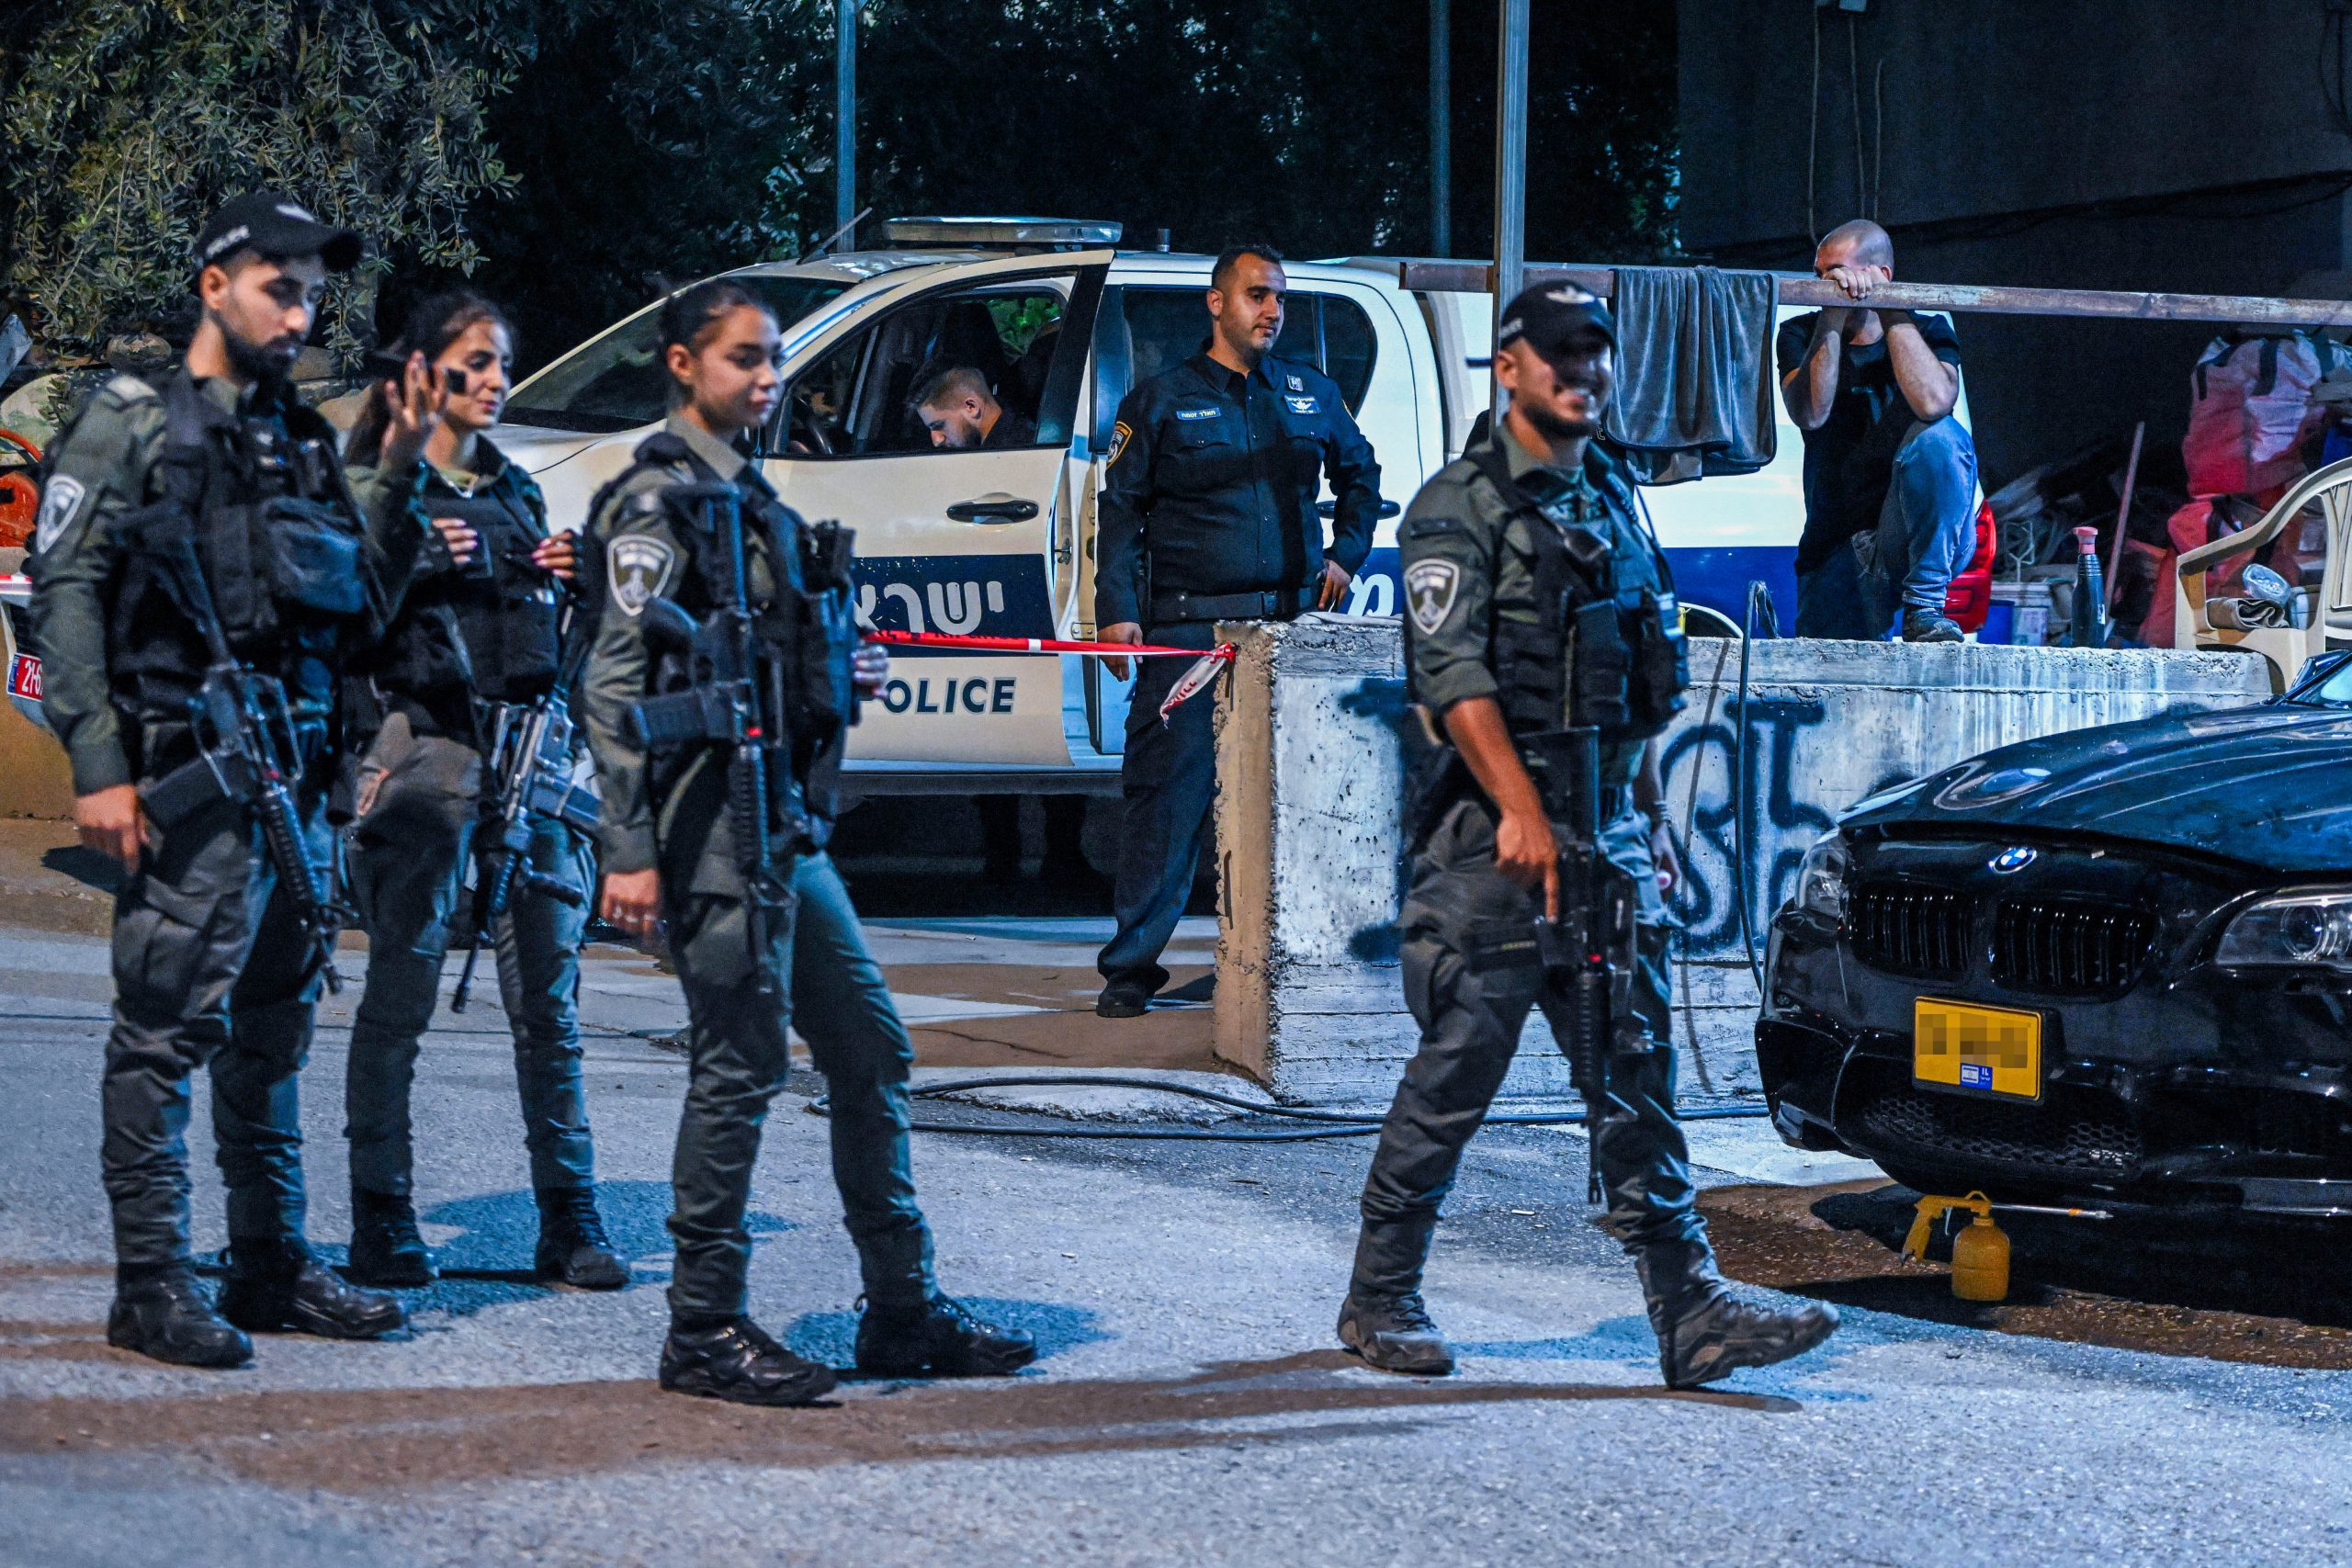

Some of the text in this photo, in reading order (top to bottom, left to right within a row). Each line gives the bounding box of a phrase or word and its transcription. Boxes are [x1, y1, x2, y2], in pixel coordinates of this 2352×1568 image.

[853, 581, 1004, 635] ישרא
[884, 677, 1016, 715] OLICE
[1982, 1067, 1989, 1077] IL
